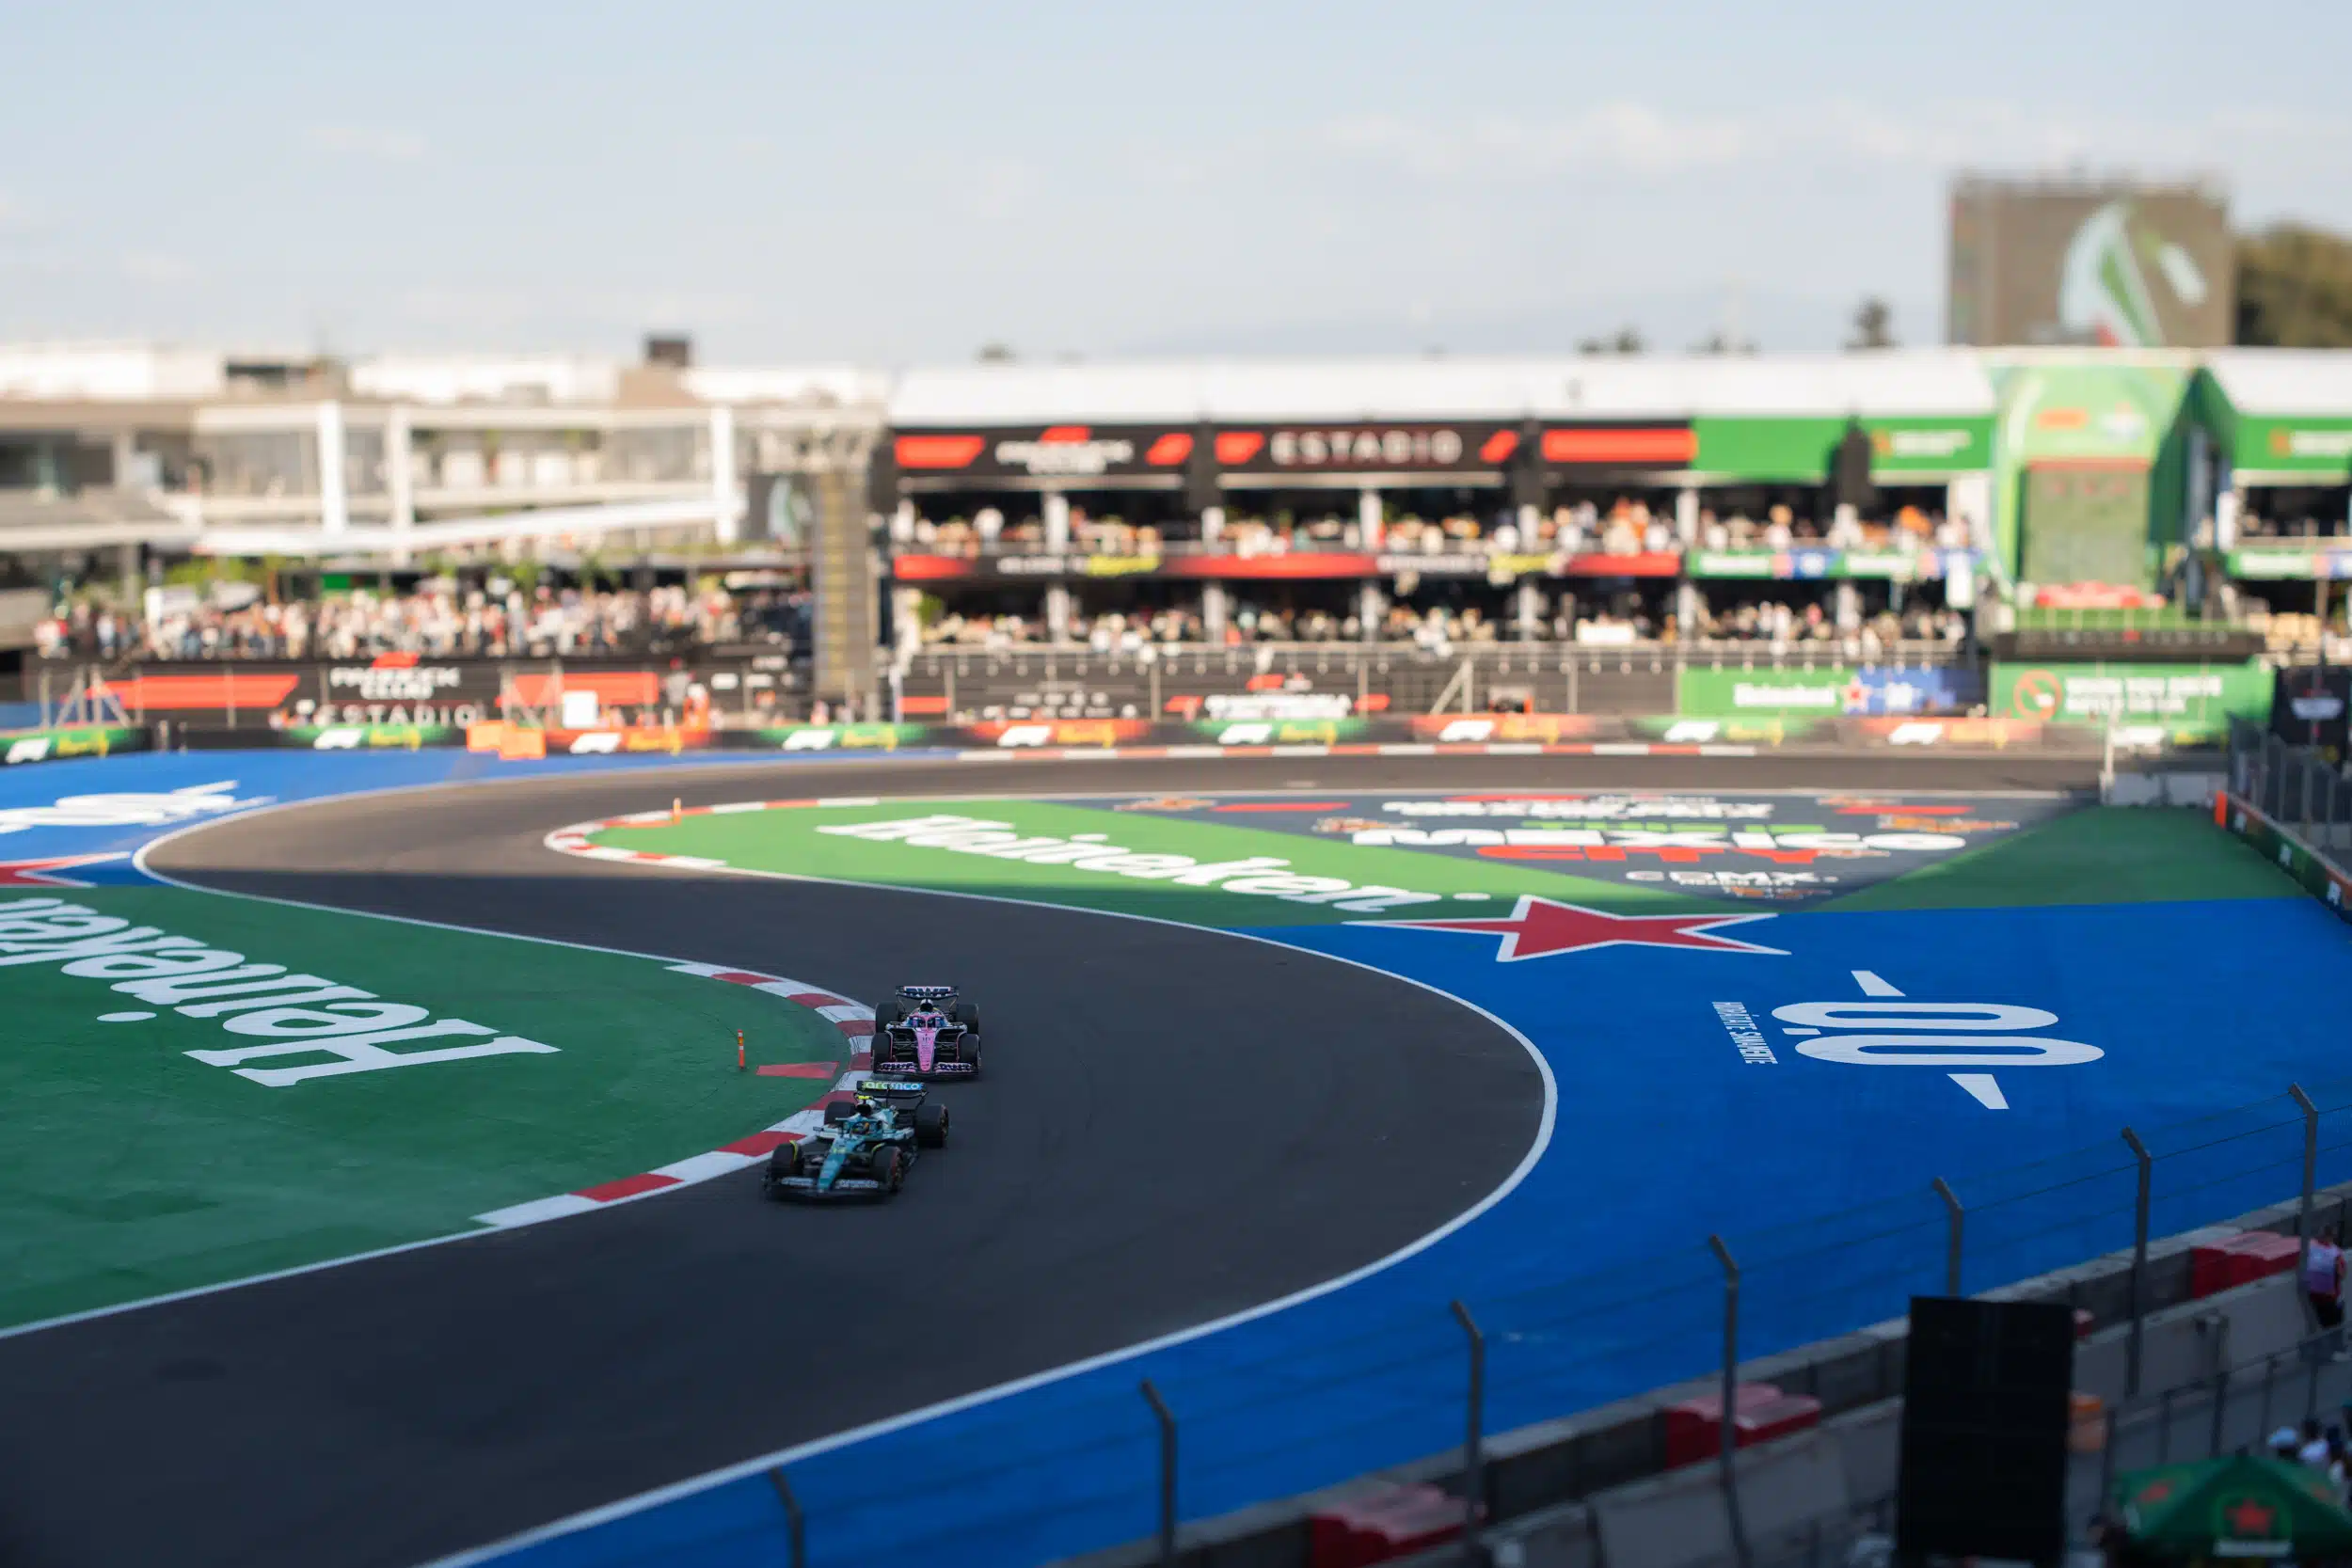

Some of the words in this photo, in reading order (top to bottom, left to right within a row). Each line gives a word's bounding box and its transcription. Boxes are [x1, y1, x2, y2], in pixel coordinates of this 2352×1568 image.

[1271, 430, 1463, 466] ESTADIO
[313, 705, 477, 728] ESTADIO
[1353, 829, 1966, 850] MEXICO
[815, 815, 1441, 912] Heineken
[1477, 846, 1821, 864] CITY
[865, 1081, 920, 1090] aramco
